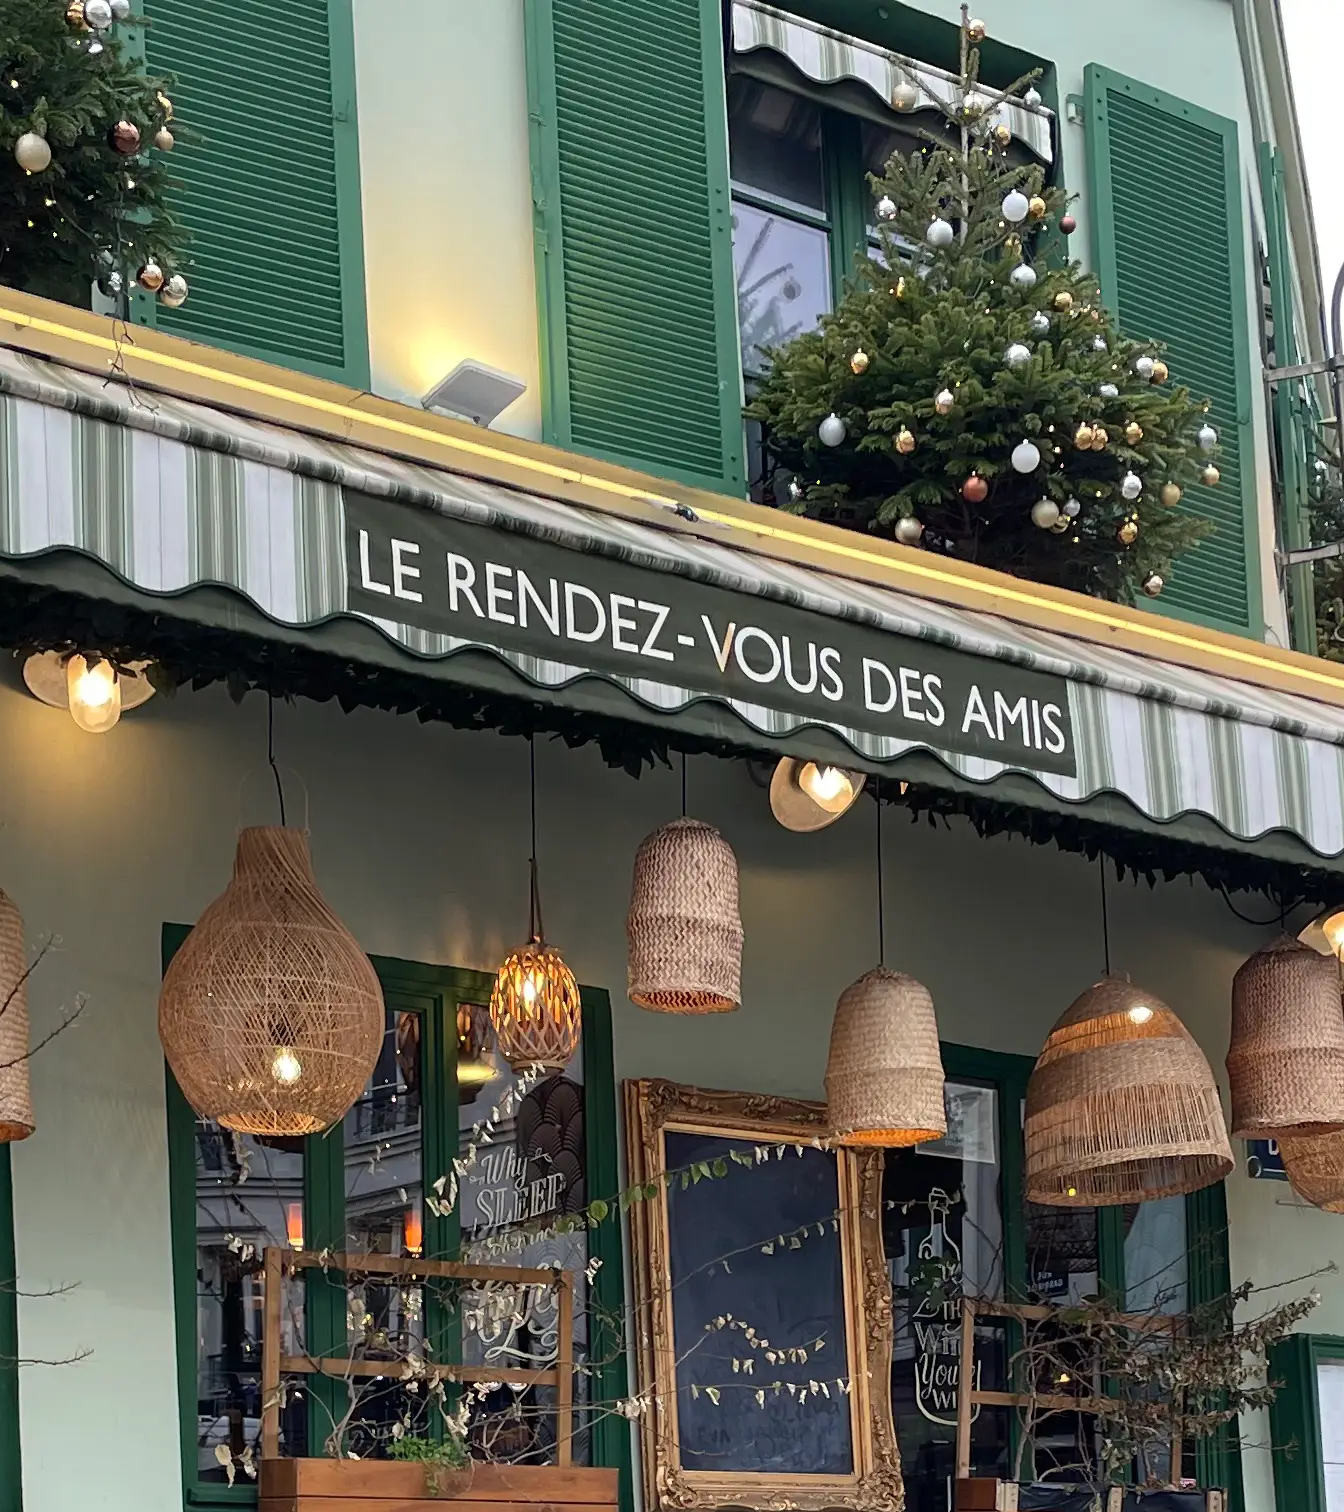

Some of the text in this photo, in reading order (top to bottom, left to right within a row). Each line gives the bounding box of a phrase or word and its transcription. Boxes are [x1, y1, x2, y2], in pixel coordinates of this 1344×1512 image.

[359, 529, 1066, 754] LE RENDEZ-VOUS DES AMIS
[475, 1145, 534, 1191] Why
[474, 1172, 567, 1230] SLEEP
